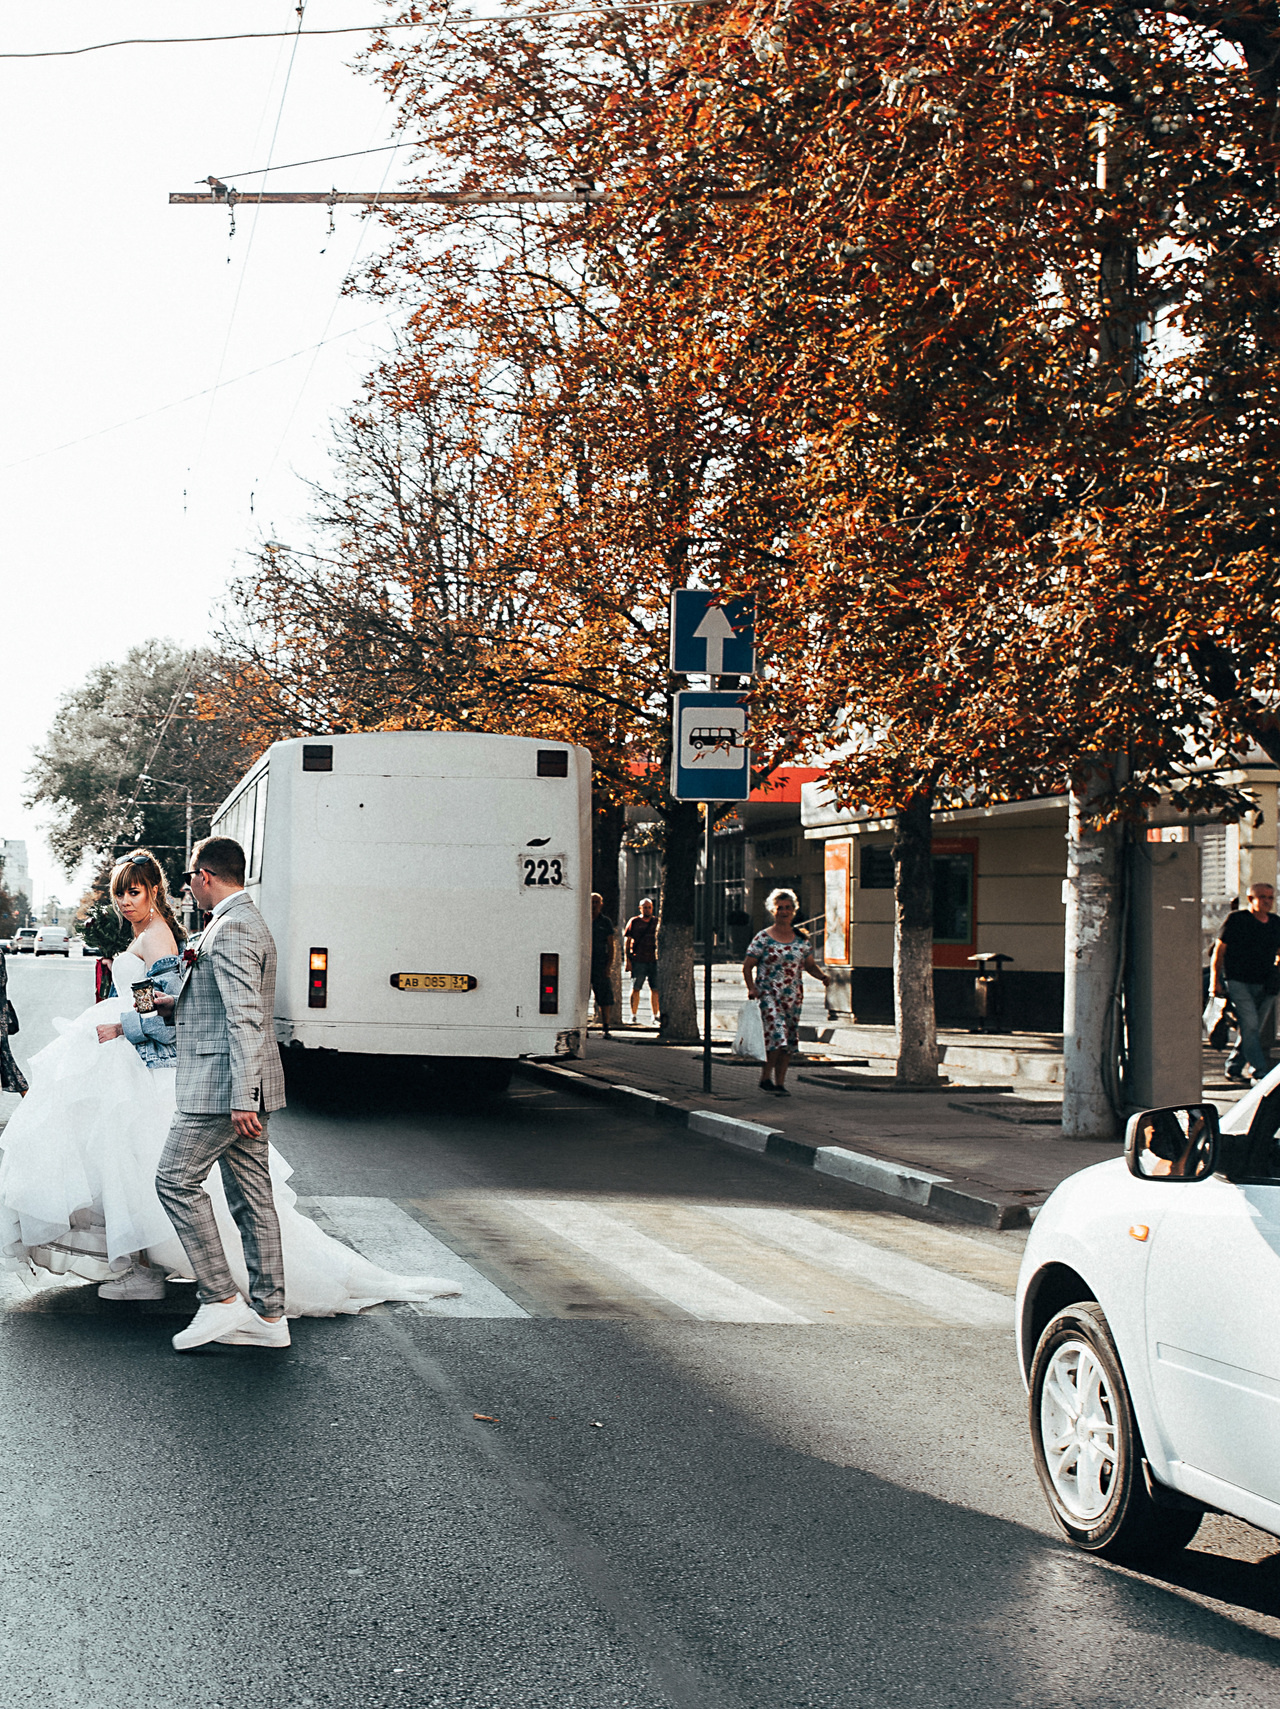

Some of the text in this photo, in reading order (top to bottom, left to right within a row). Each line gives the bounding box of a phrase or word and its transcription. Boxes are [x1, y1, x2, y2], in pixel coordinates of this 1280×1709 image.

[524, 859, 563, 886] 223
[424, 976, 446, 988] 085
[452, 976, 465, 986] 31
